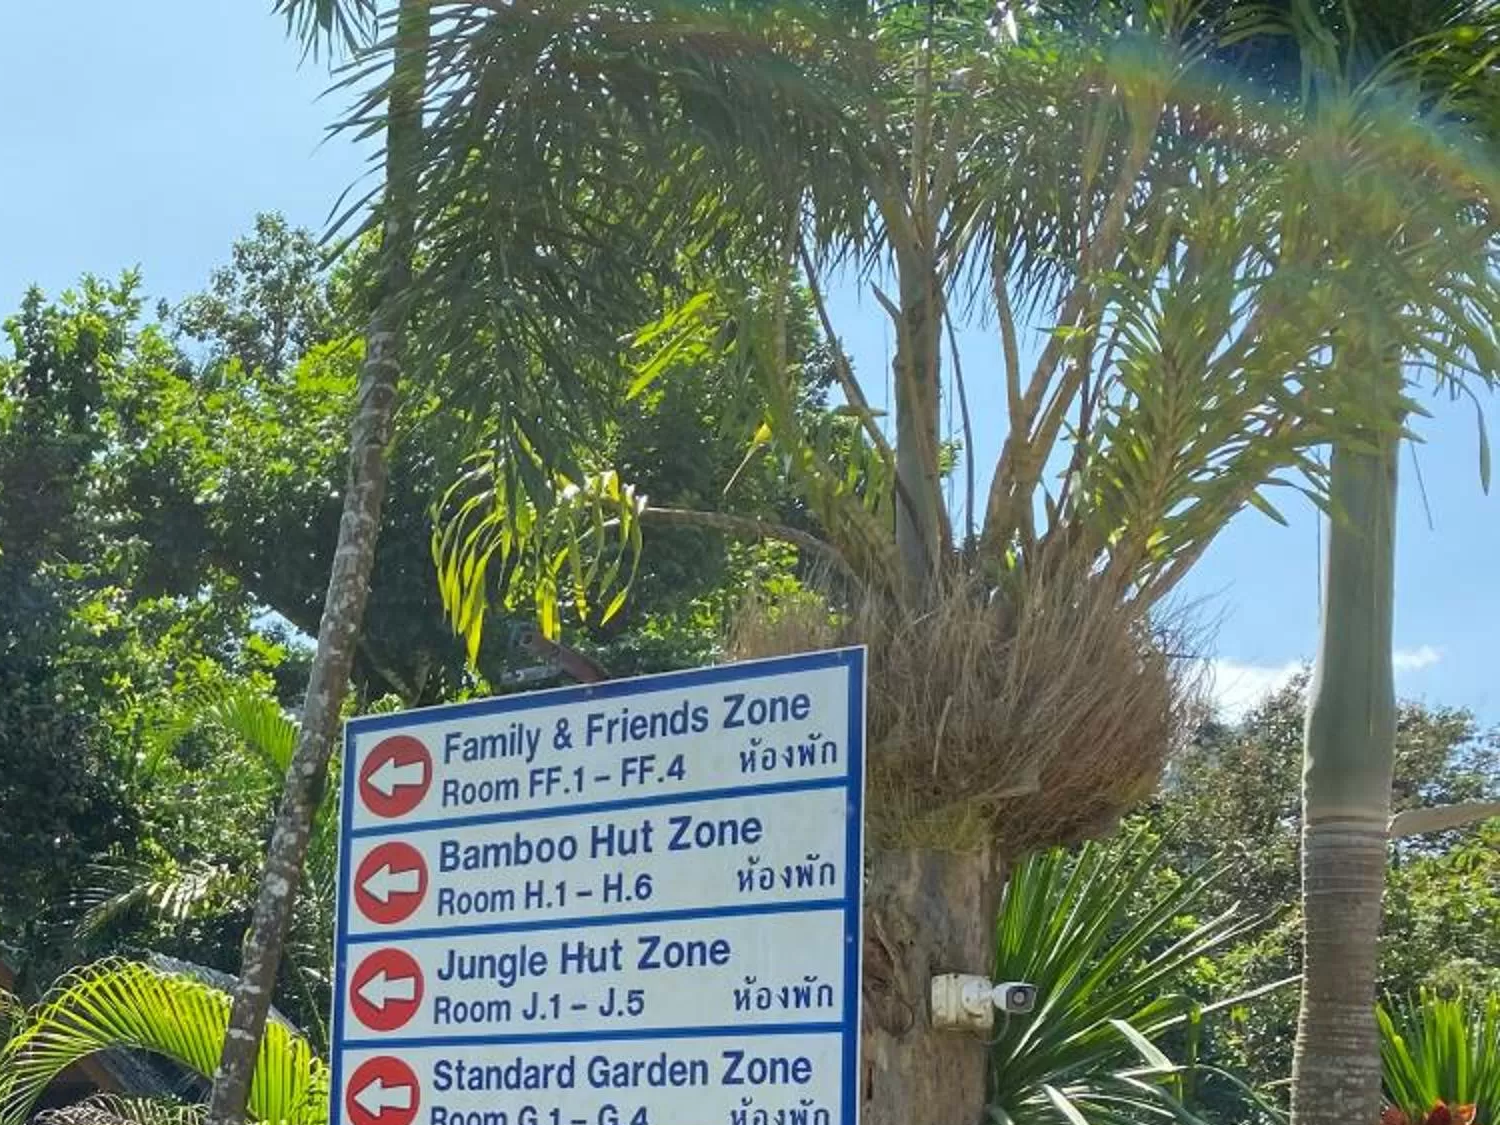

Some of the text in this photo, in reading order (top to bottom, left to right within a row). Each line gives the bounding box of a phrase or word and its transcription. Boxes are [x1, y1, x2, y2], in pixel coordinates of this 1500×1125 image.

[444, 693, 811, 764] Family & Friends Zone
[740, 732, 837, 773] ห้องพัก
[442, 778, 519, 808] Room
[529, 766, 584, 798] FF.1
[621, 754, 686, 787] FF.4
[440, 816, 762, 872] Bamboo Hut Zone
[437, 888, 514, 917] Room
[525, 880, 566, 910] H.1
[603, 872, 652, 904] H.6
[737, 854, 835, 892] ห้องพัก
[437, 936, 731, 988] Jungle Hut Zone
[434, 996, 511, 1024] Room
[522, 992, 560, 1020] J.1
[599, 987, 644, 1017] J.5
[733, 976, 833, 1011] ห้องพัก
[433, 1050, 812, 1092] Standard Garden Zone
